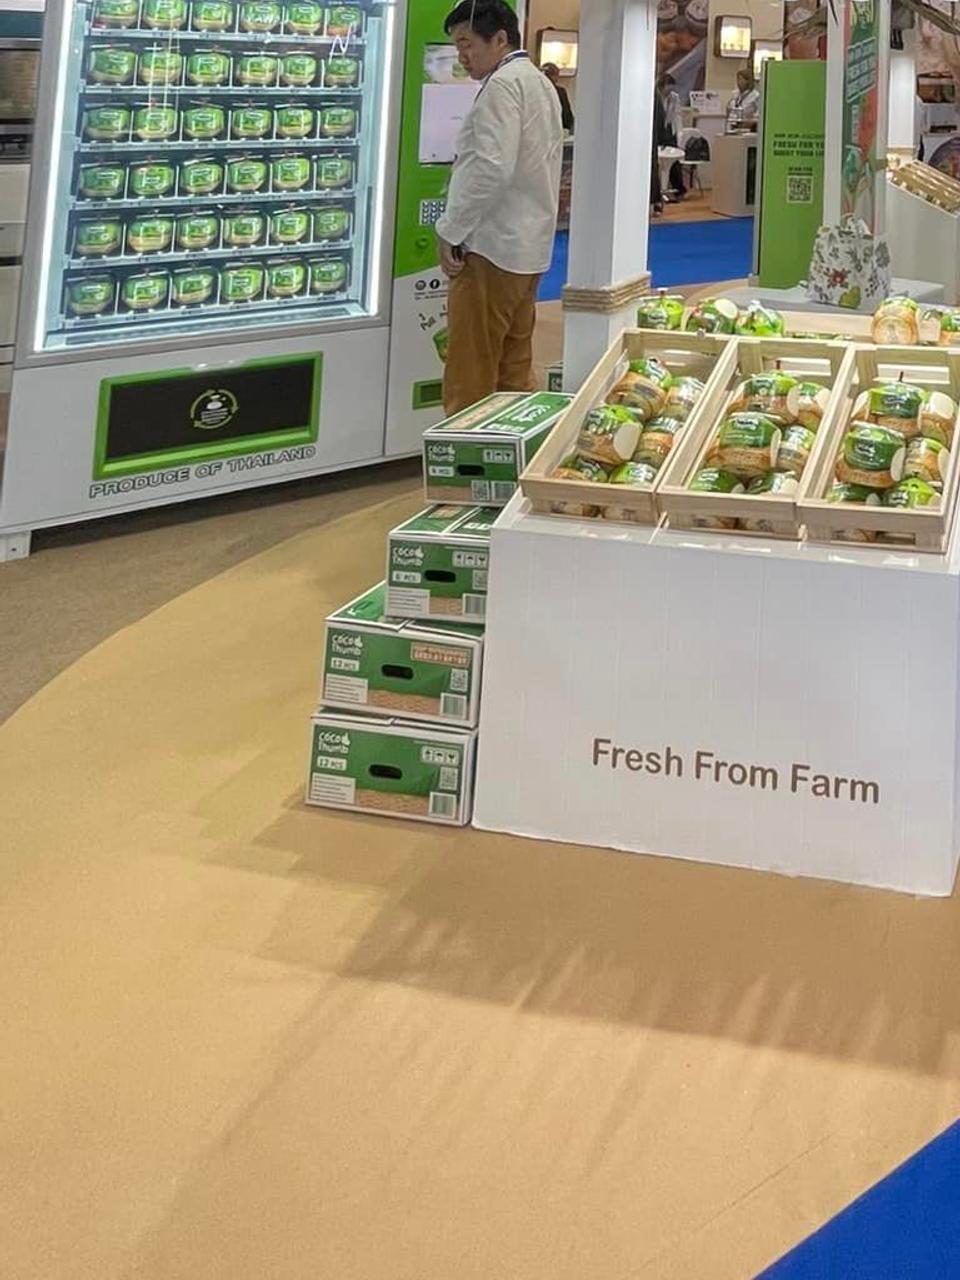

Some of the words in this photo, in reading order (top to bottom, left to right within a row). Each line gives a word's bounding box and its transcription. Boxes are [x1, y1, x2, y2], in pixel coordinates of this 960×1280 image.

[89, 468, 190, 499] PRODUCE
[195, 463, 223, 479] OF
[226, 446, 317, 473] THAILAND
[593, 738, 683, 778] Fresh
[695, 751, 778, 791] From
[791, 764, 880, 804] Farm
